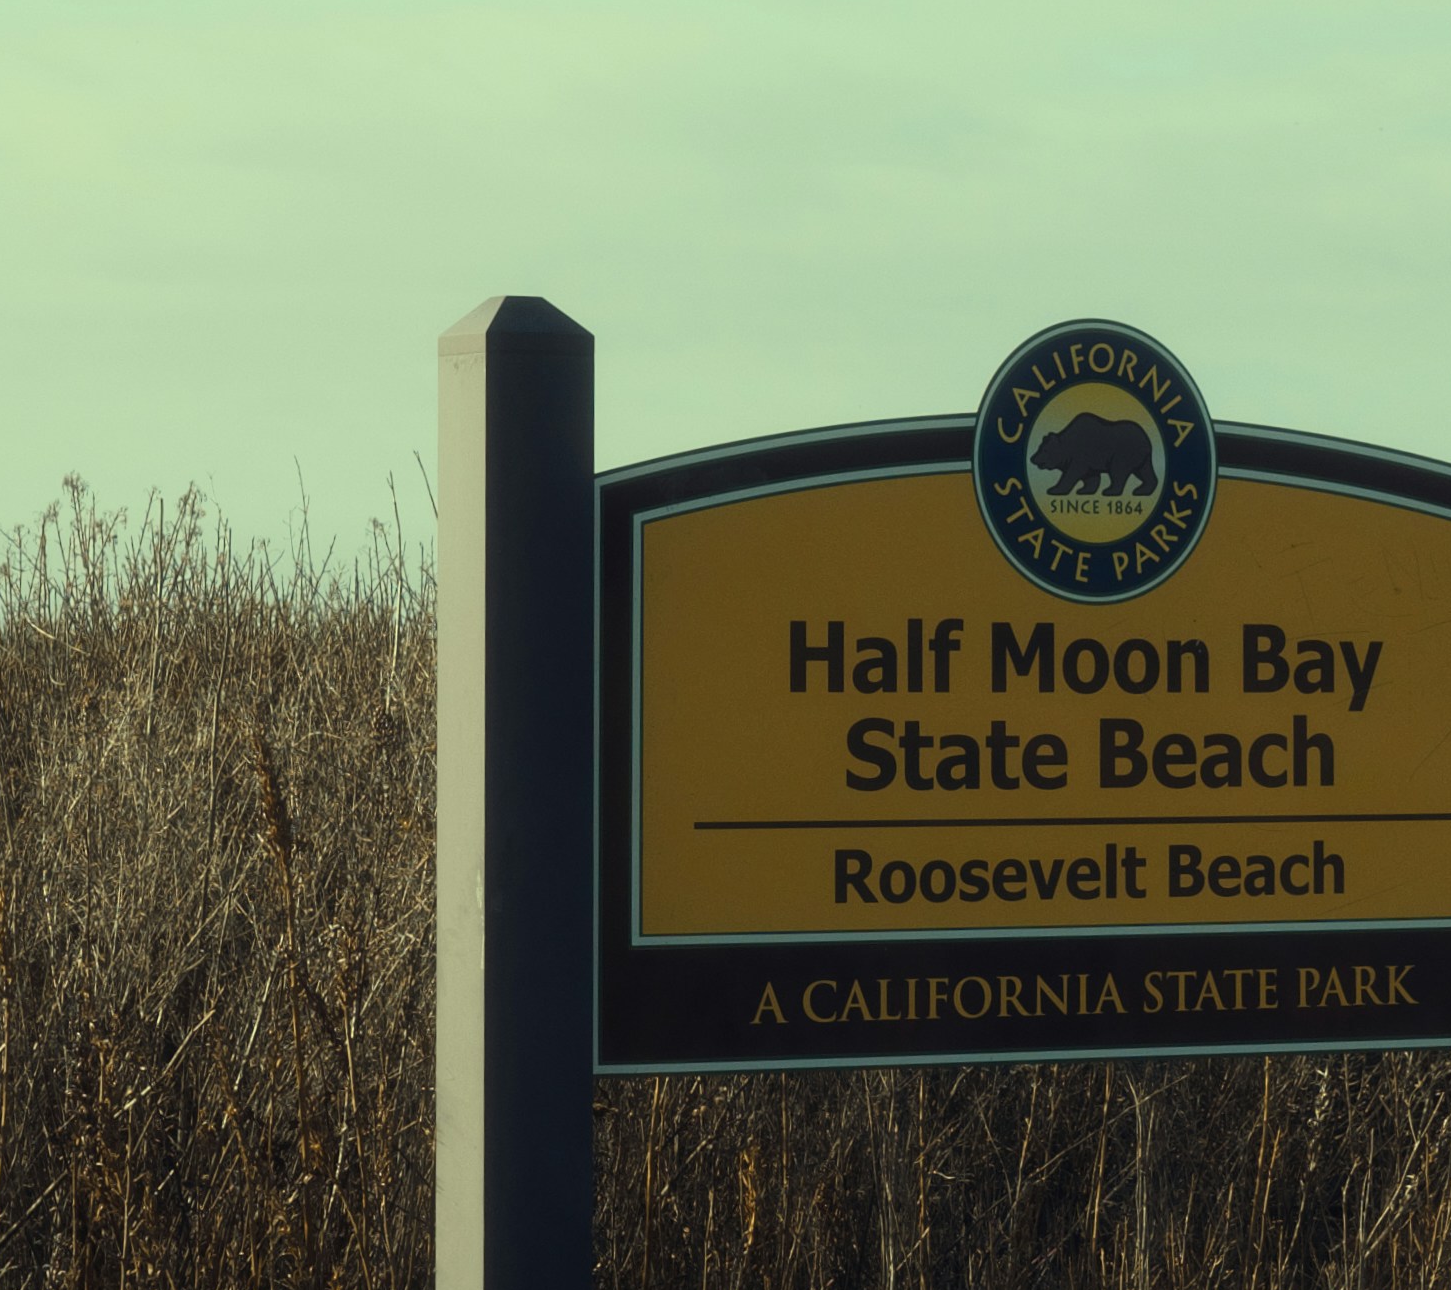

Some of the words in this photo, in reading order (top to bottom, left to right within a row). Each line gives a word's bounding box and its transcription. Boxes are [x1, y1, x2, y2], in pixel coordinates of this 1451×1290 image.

[998, 343, 1195, 448] CALIFORNIA
[994, 477, 1092, 583] STATE
[1112, 481, 1198, 581] PARKS
[1050, 499, 1100, 514] SINCE
[1107, 500, 1143, 515] 1864
[790, 619, 963, 694] Half
[992, 622, 1209, 694] Moon
[1243, 624, 1383, 711] Bay
[846, 718, 1068, 791] State
[1100, 715, 1334, 789] Beach
[835, 844, 1146, 903] Roosevelt
[1169, 841, 1344, 897] Beach
[751, 982, 787, 1023] A
[803, 973, 1126, 1022] CALIFORNIA
[1144, 969, 1277, 1012] STATE
[1299, 966, 1418, 1007] PARK
